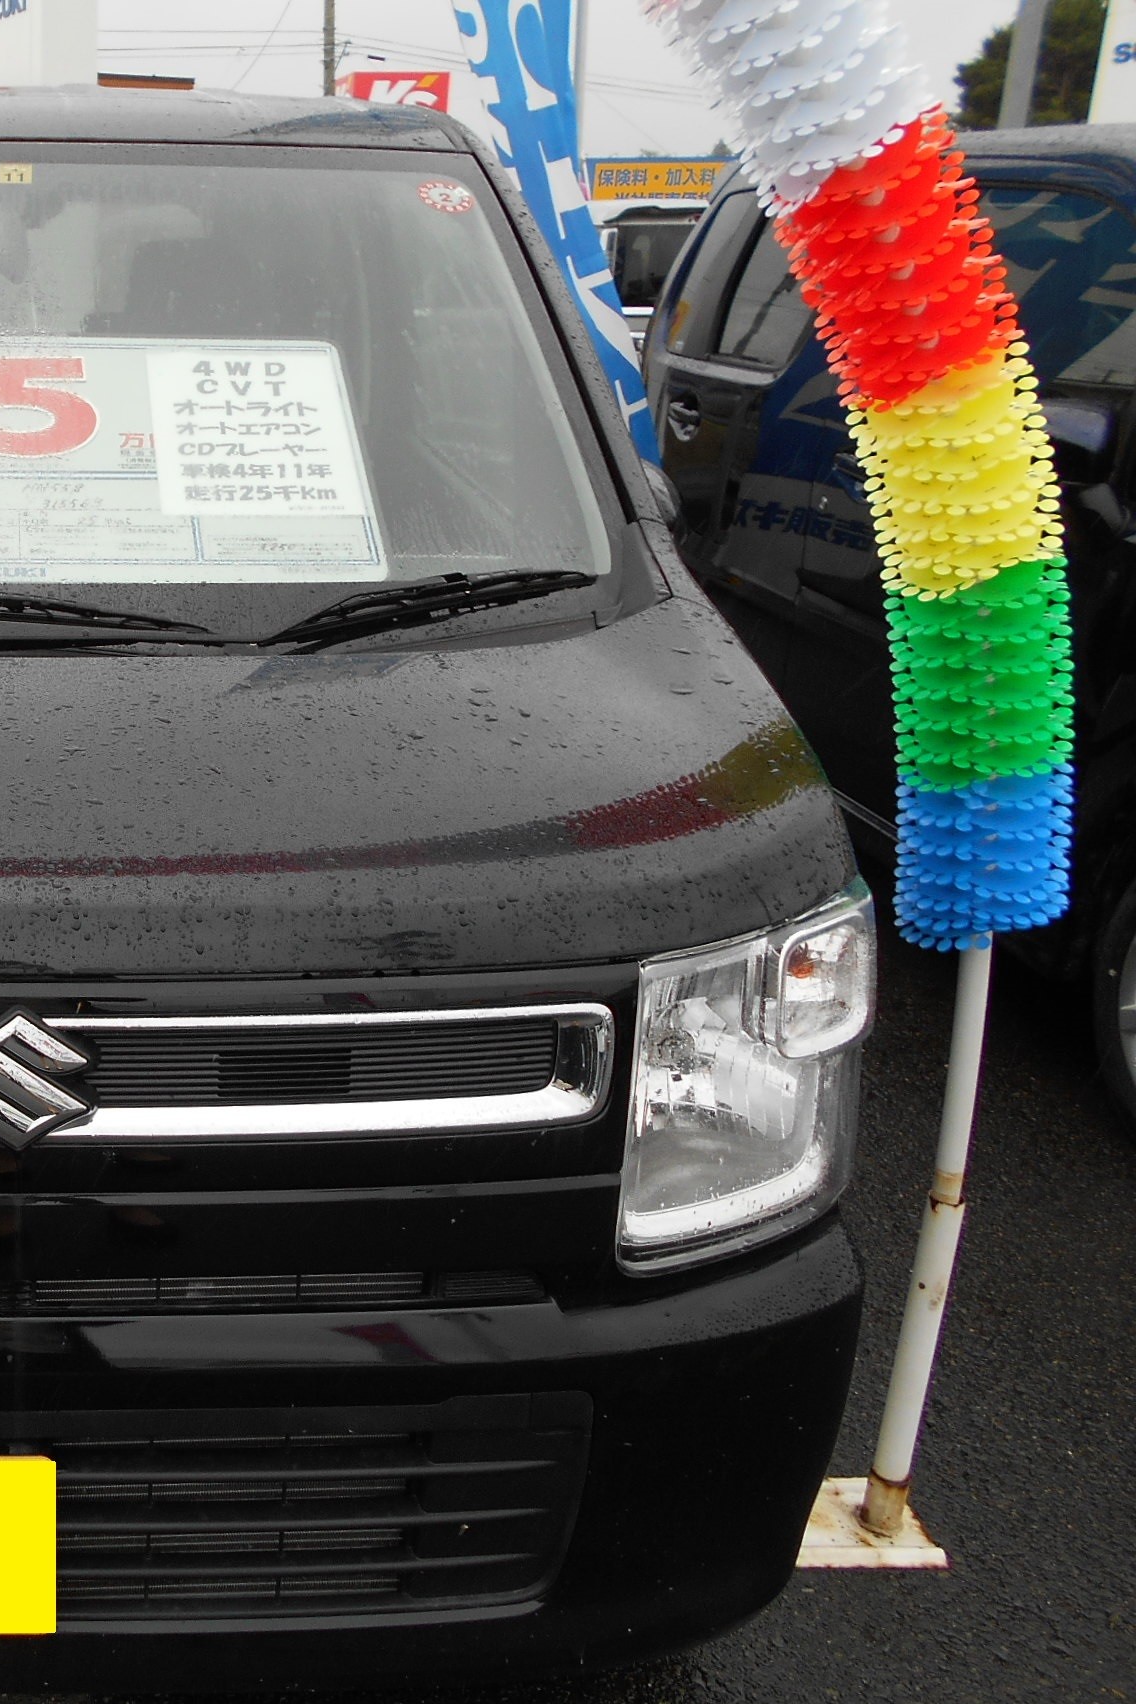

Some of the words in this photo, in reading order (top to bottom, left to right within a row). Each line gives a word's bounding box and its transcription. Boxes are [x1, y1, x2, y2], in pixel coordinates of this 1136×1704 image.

[173, 399, 319, 417] オートライト
[176, 421, 322, 436] オートエアコン
[119, 432, 154, 448] 万
[177, 442, 328, 457] CDプレーヤー
[184, 485, 338, 501] 走行25千km
